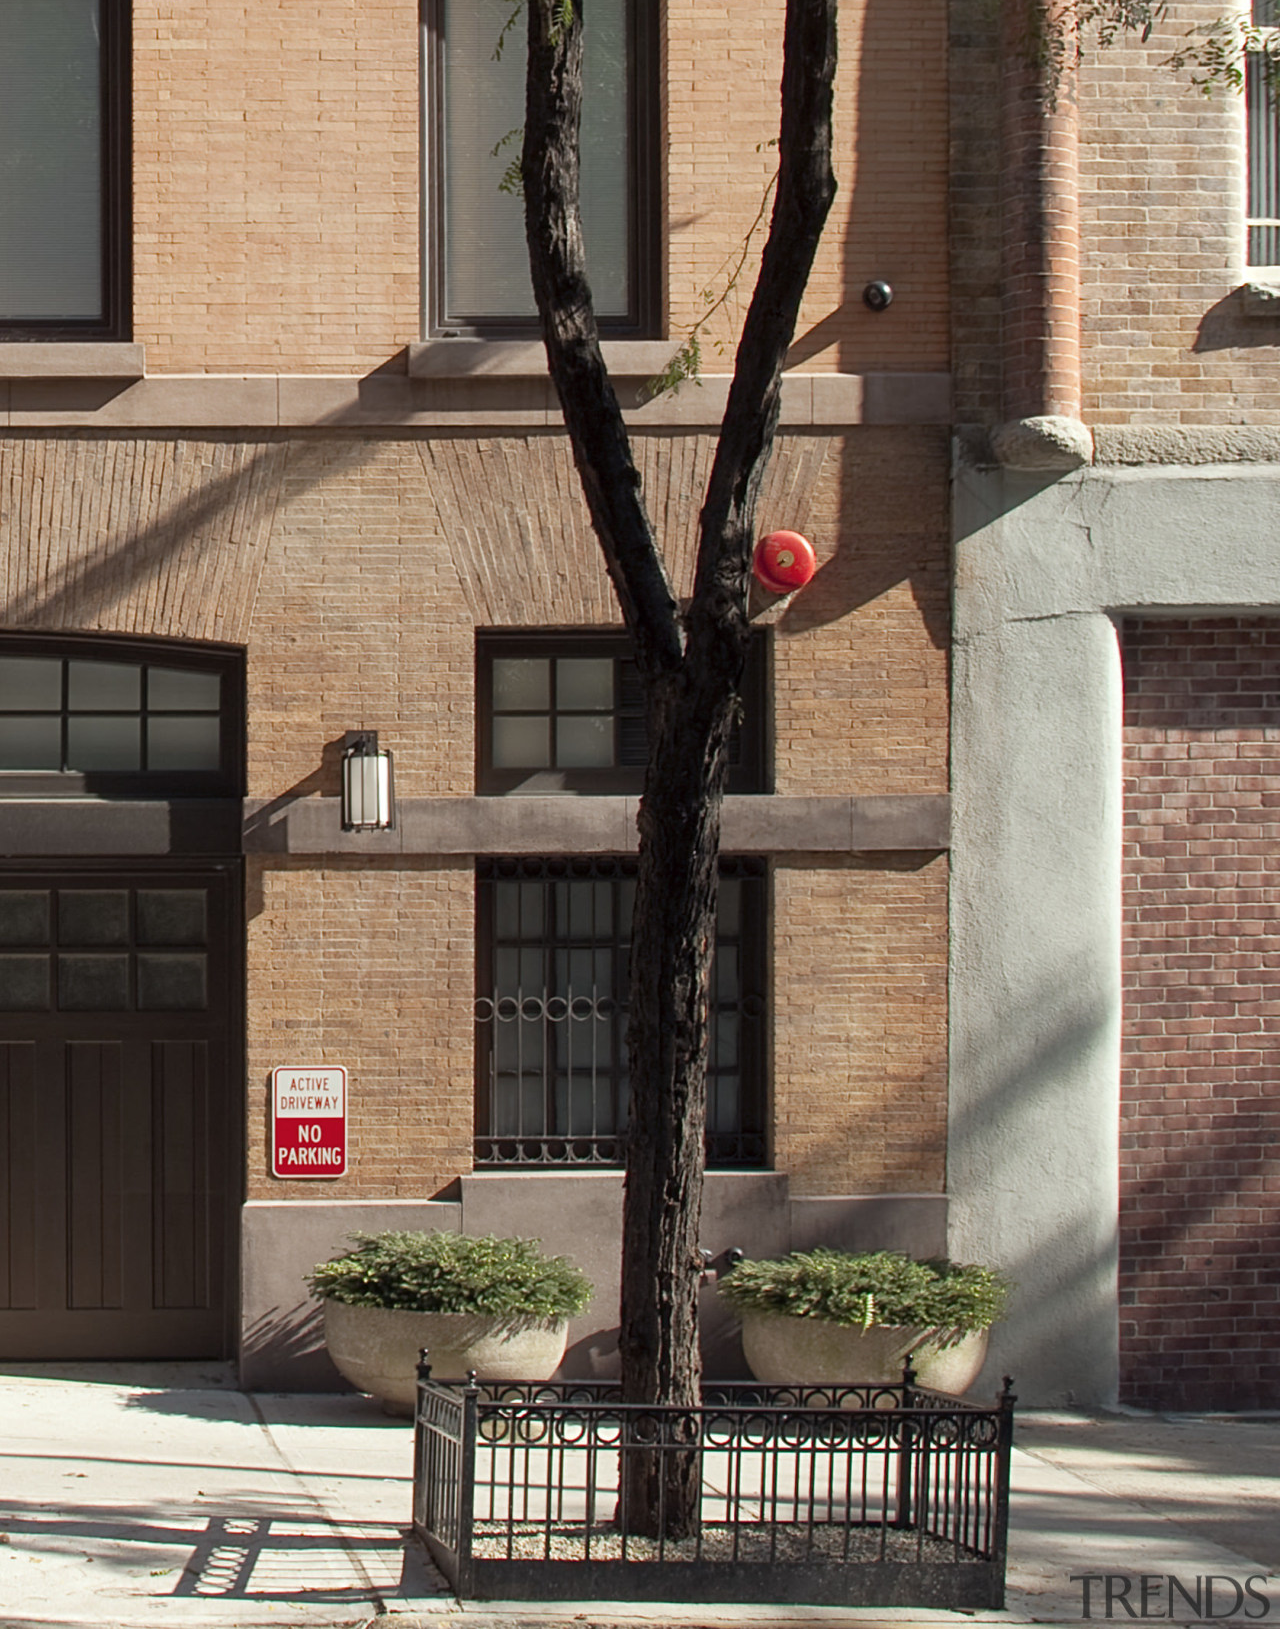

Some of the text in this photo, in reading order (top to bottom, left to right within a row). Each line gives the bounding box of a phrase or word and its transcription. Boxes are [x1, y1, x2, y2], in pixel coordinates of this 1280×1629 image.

[290, 1077, 330, 1091] ACTIVE
[280, 1096, 339, 1110] DRIVEWAY
[298, 1125, 322, 1143] NO
[278, 1147, 342, 1165] PARKING
